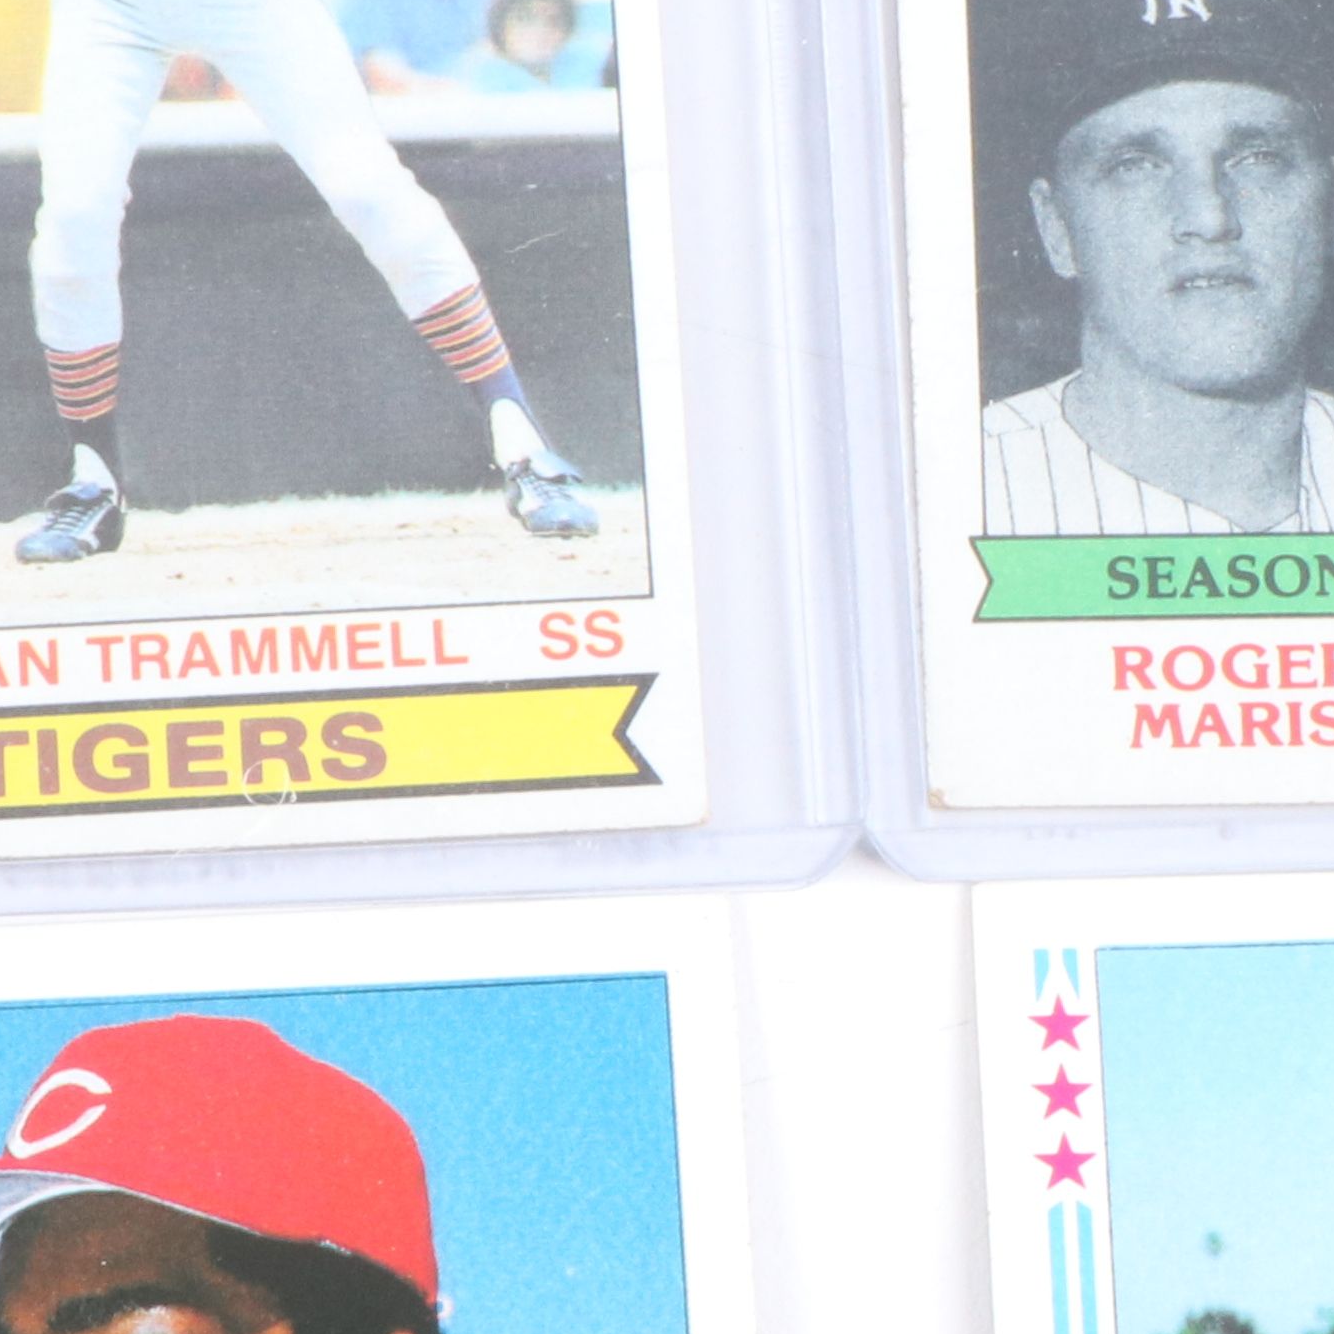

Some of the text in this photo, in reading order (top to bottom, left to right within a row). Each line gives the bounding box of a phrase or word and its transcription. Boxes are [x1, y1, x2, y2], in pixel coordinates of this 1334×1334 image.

[88, 620, 468, 682] TRAMMELL
[539, 609, 624, 661] SS
[5, 1067, 113, 1159] C
